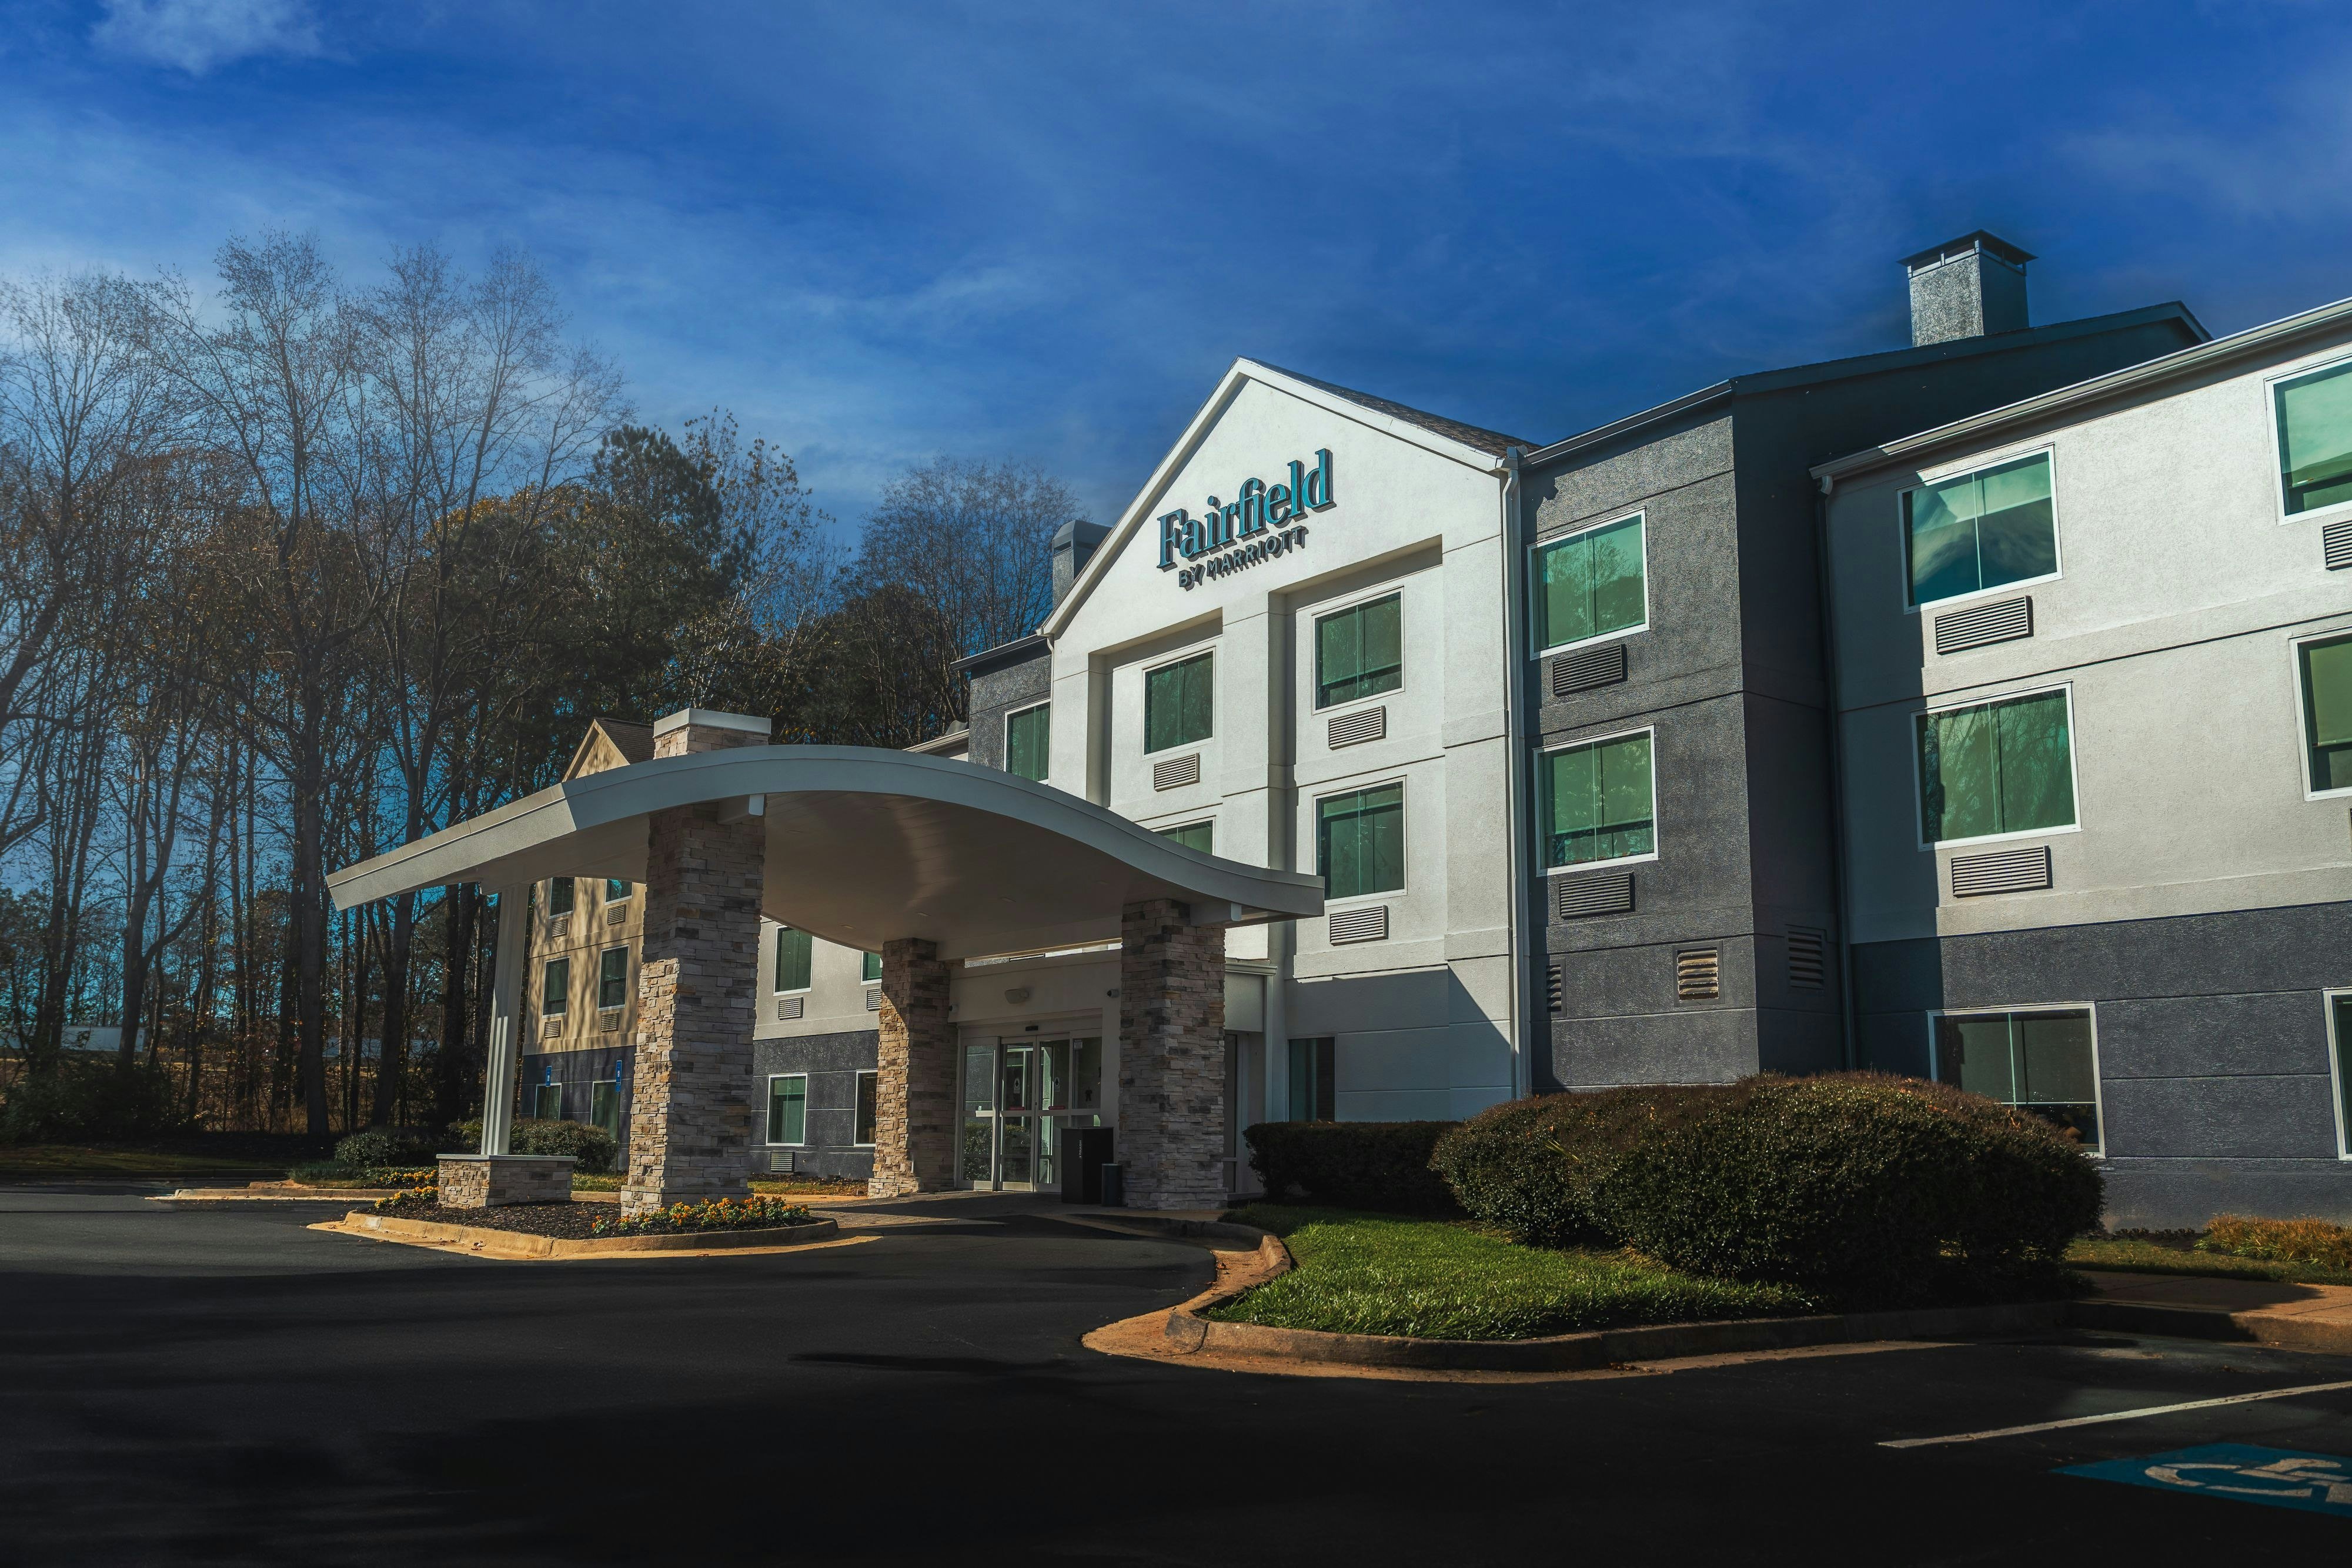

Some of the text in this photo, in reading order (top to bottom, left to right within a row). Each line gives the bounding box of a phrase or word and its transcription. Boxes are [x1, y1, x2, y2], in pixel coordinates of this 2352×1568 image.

[1157, 448, 1335, 571] Fairfield
[1178, 526, 1308, 589] BY MARRIOTT
